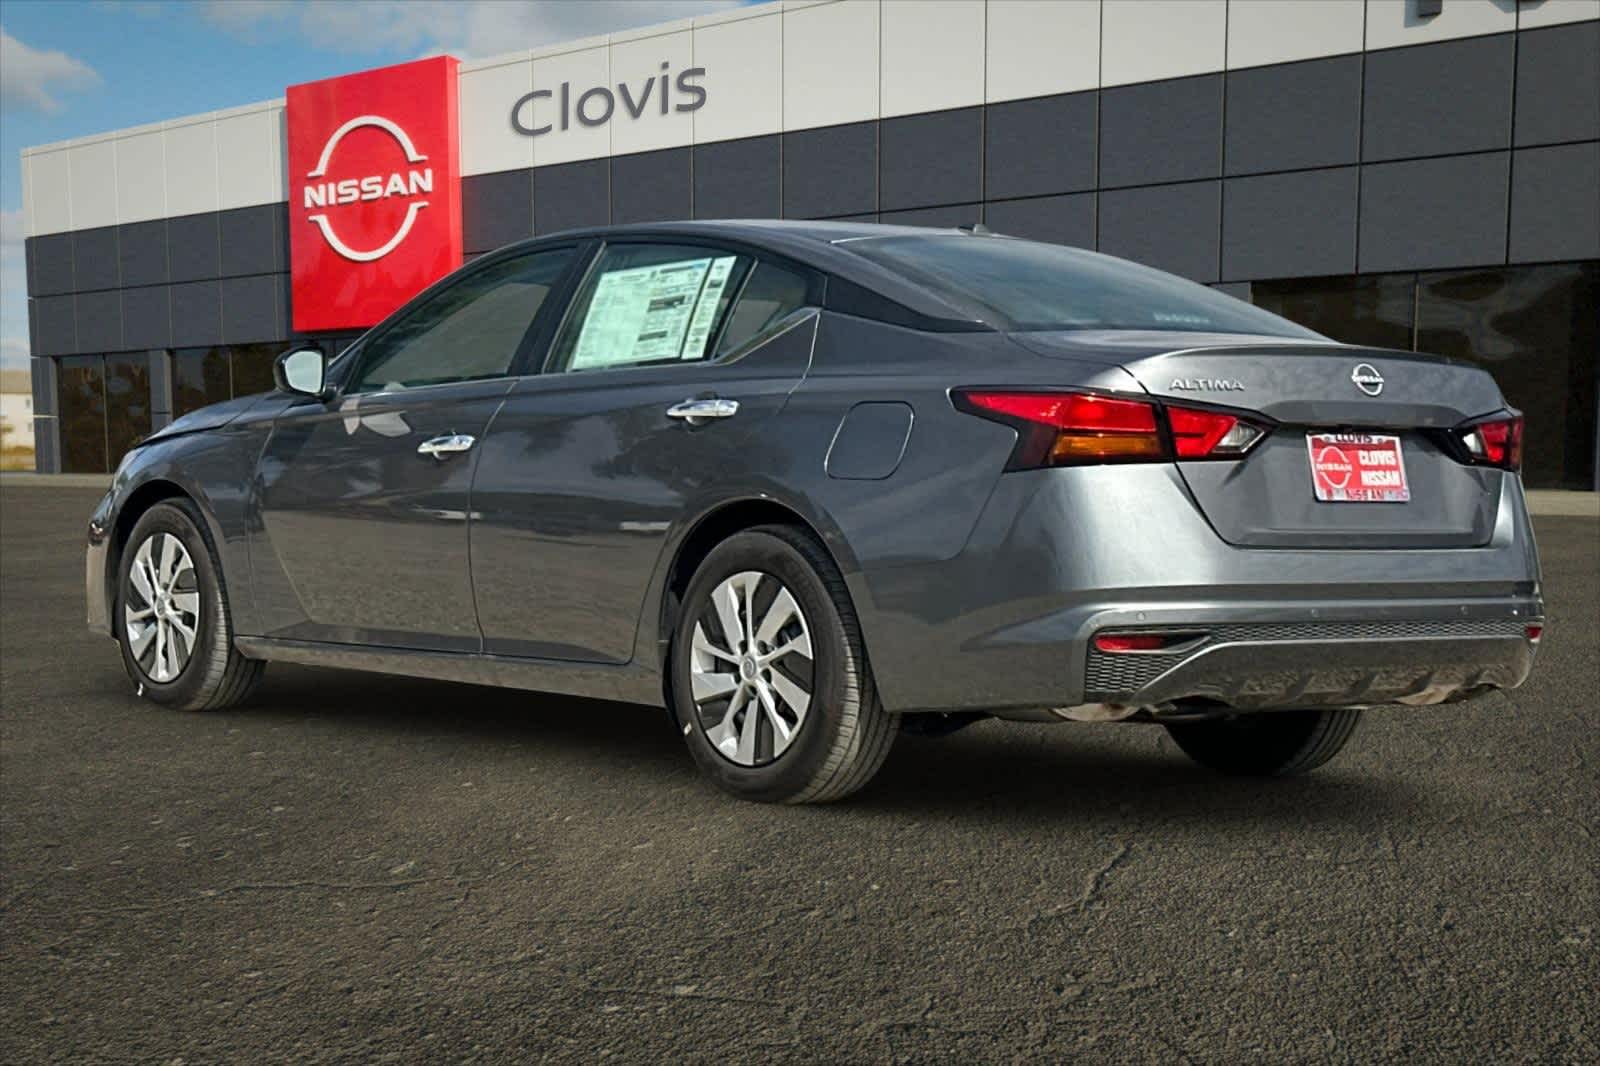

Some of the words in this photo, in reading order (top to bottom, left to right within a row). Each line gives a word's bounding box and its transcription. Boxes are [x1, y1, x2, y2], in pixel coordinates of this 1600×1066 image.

[510, 61, 708, 137] Clovis
[303, 168, 433, 209] NISSAN
[1169, 377, 1245, 391] ALTIMA
[1358, 450, 1397, 466] CLOVIS
[1361, 470, 1401, 487] NISSAN
